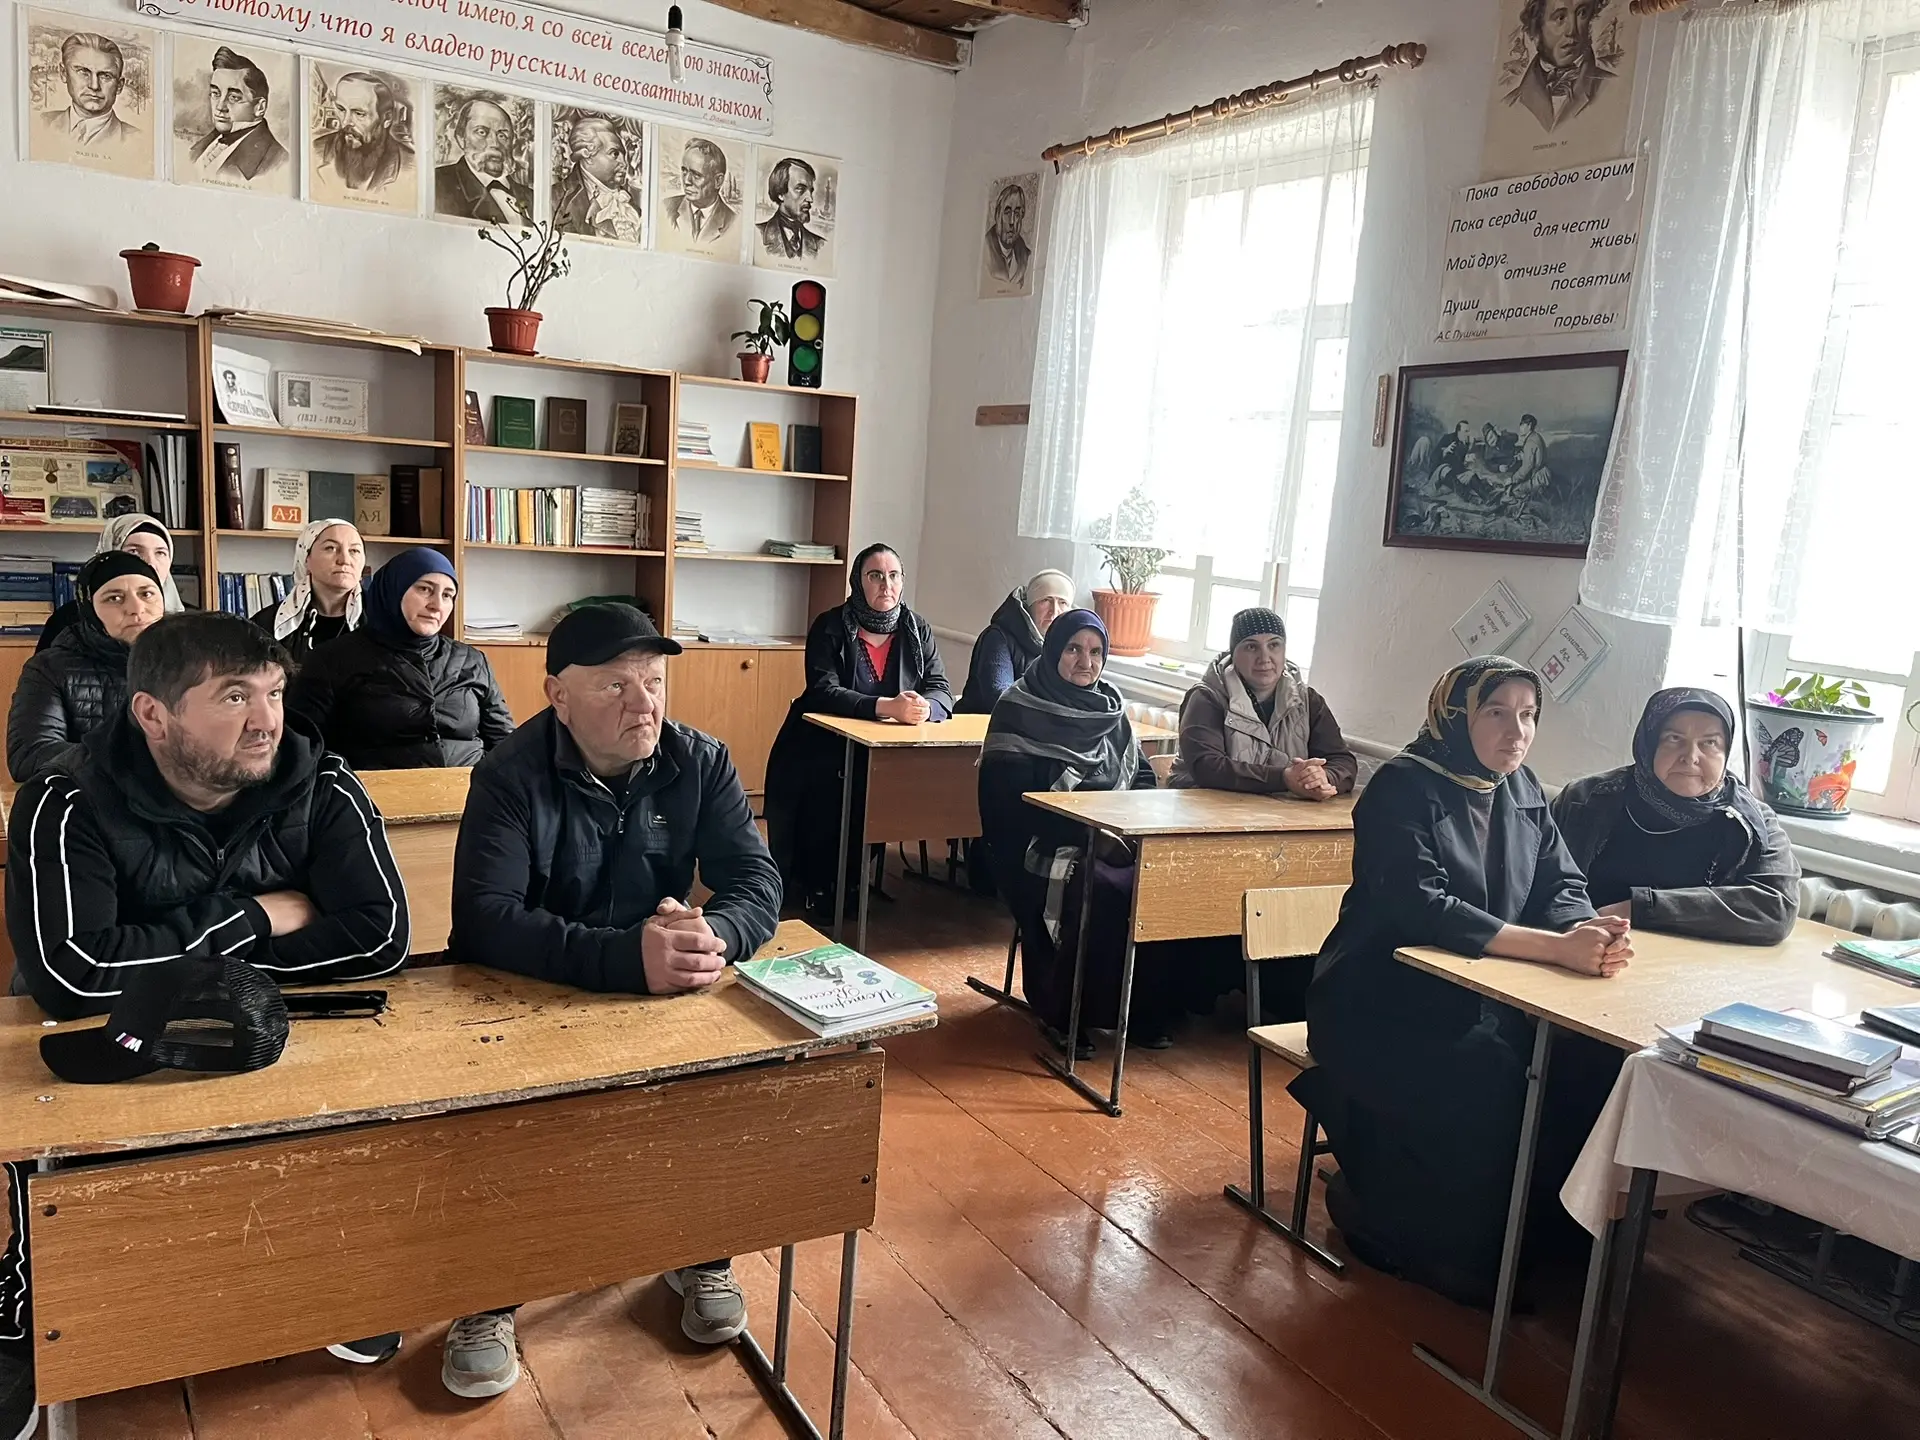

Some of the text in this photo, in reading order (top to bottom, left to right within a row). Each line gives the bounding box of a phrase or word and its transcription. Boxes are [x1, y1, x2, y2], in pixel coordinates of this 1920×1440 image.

[458, 1, 519, 31] имею,
[521, 15, 535, 32] я
[542, 20, 564, 38] со
[572, 28, 613, 51] всей
[621, 40, 704, 72] вселеою
[319, 11, 373, 39] что
[380, 26, 395, 44] я
[404, 32, 484, 61] владею
[489, 47, 587, 83] русским
[593, 72, 705, 109] всеохватным
[1465, 162, 1635, 202] Пока свободою горим
[1450, 208, 1538, 234] Пока сердца
[1533, 217, 1610, 238] для чести
[1446, 254, 1476, 272] Мой
[1503, 261, 1567, 281] отчизне
[1550, 271, 1632, 291] посвятим
[1442, 298, 1480, 317] Души
[1475, 303, 1559, 324] прекрасные
[1553, 312, 1619, 330] порывы!
[813, 988, 905, 1012] История
